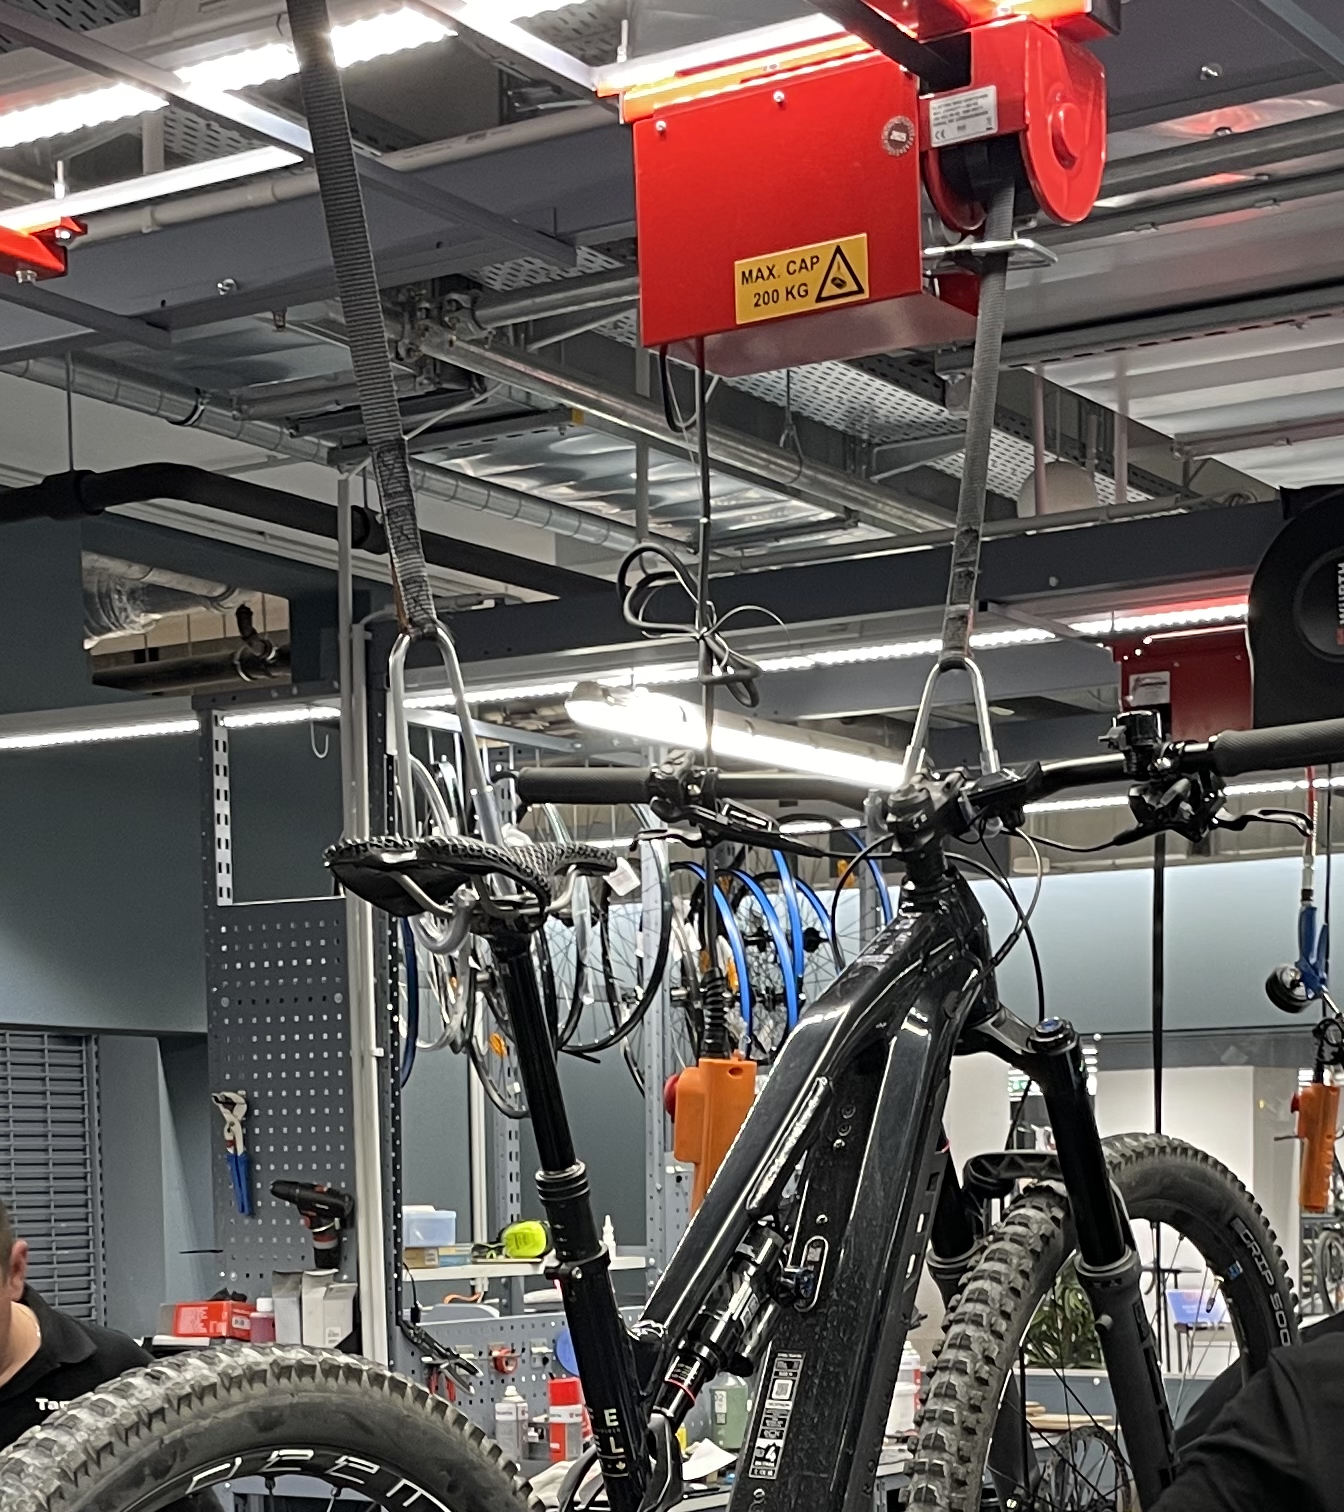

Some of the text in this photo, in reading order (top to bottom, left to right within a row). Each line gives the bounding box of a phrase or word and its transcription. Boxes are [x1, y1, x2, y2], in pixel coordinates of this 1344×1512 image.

[741, 255, 820, 285] MAX. CAP
[753, 282, 809, 308] 200 KG
[1269, 1292, 1292, 1347] 500
